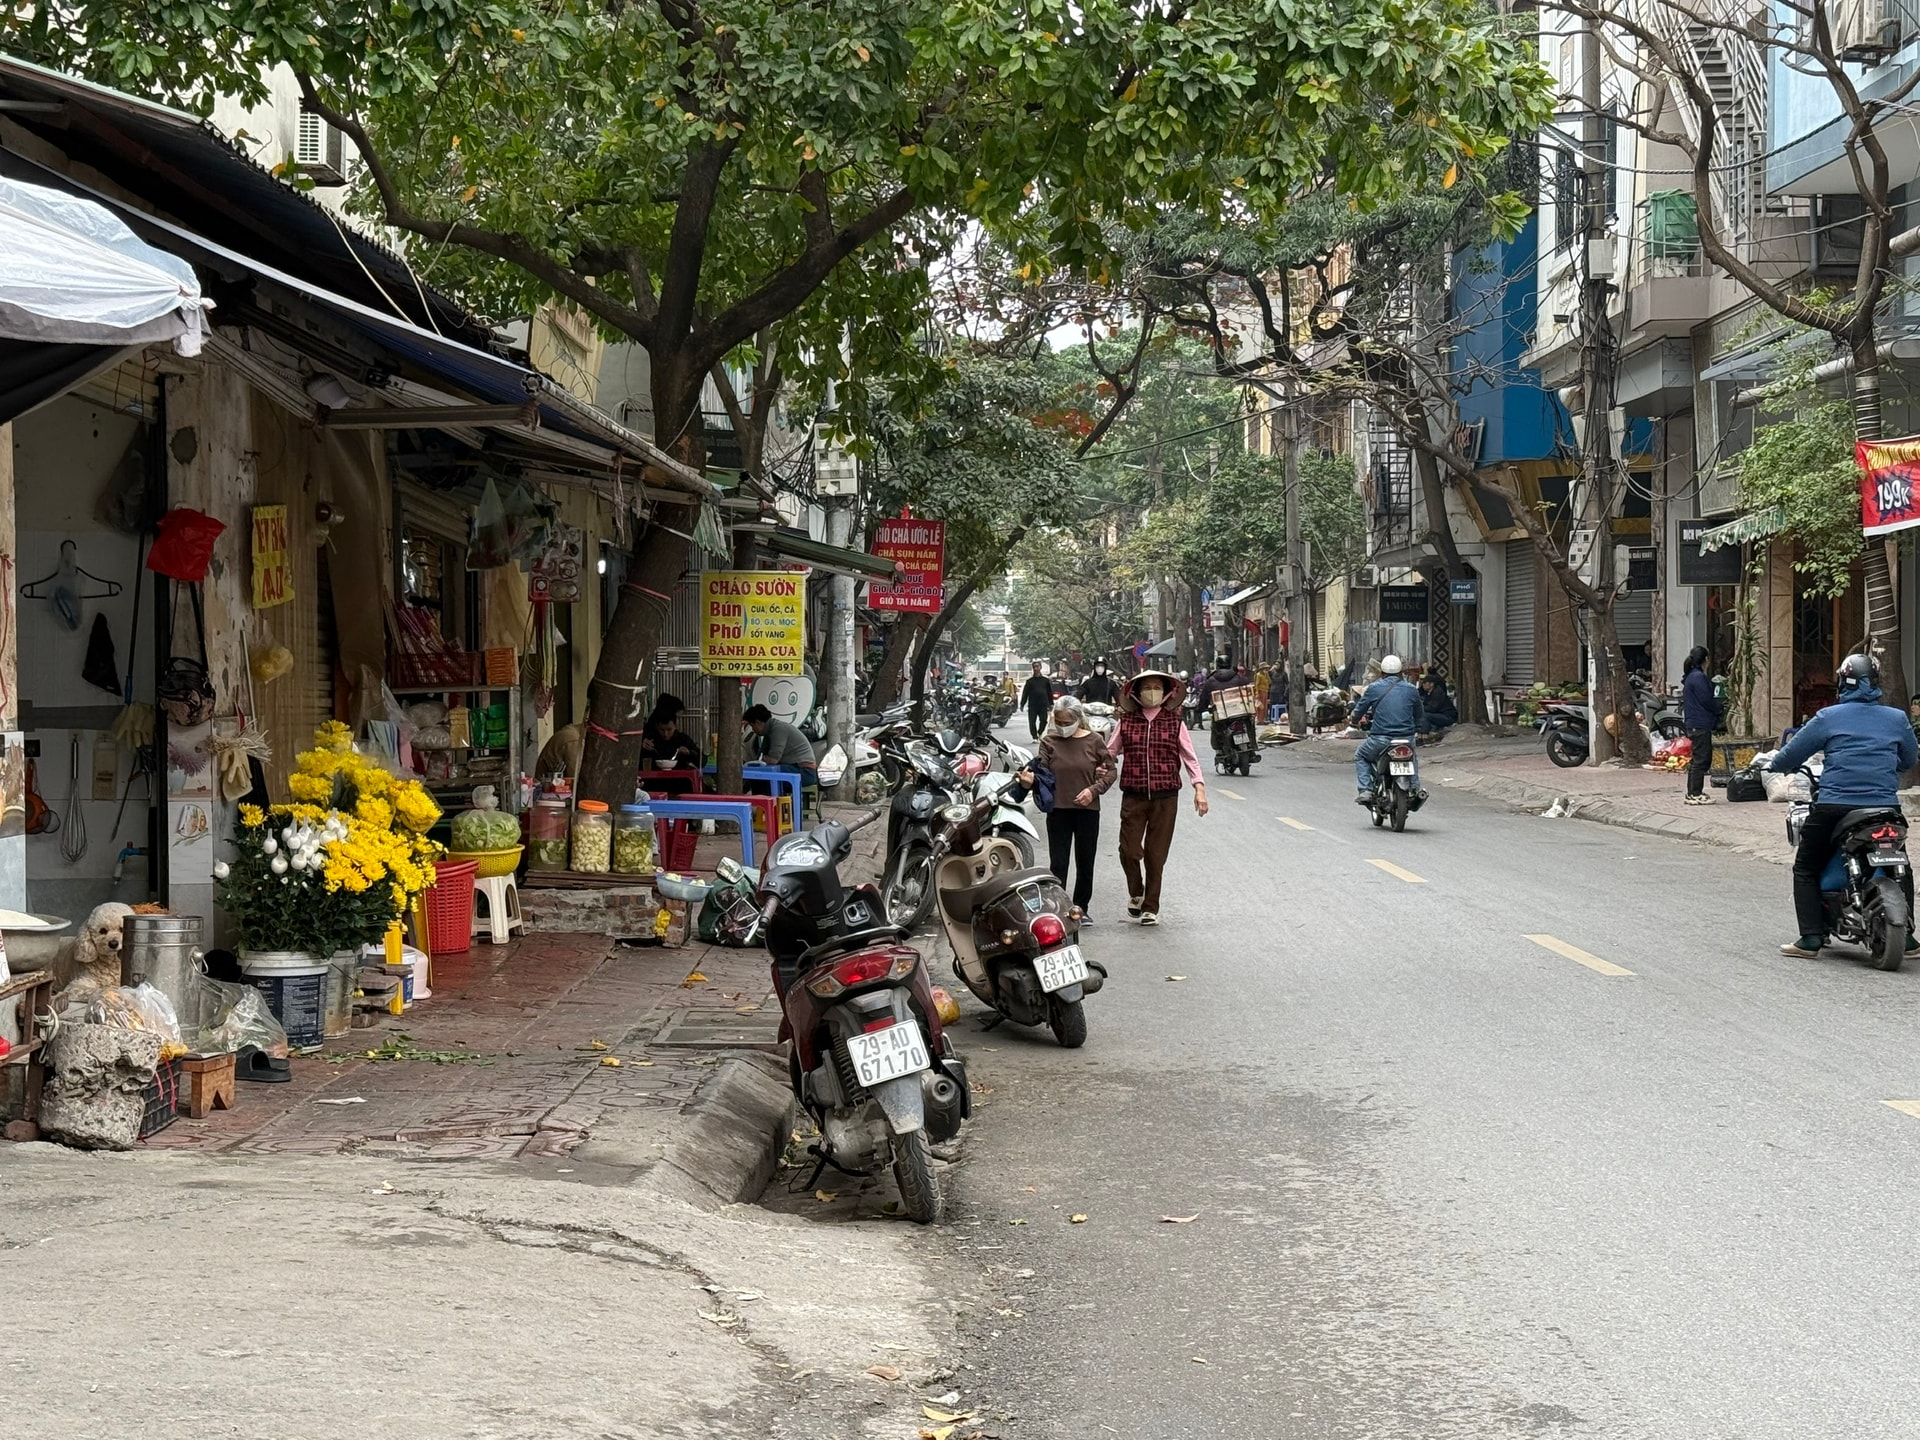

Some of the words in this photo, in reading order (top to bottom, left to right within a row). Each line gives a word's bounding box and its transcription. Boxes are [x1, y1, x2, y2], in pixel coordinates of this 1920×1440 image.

[892, 523, 909, 544] CHẢ
[911, 525, 929, 545] ƯỚC
[930, 524, 940, 546] LỄ
[878, 547, 894, 557] CHẢ
[897, 549, 915, 559] SỤN
[905, 560, 920, 570] CHẢ
[709, 577, 751, 595] CHÁO
[755, 578, 796, 596] SƯỜN
[710, 601, 742, 617] Bún
[751, 605, 767, 614] CUA,
[769, 603, 782, 614] ỐC,
[880, 596, 894, 605] GIÒ
[896, 597, 908, 606] TAI
[709, 621, 742, 639] Phở
[751, 629, 763, 638] SỐT
[708, 643, 744, 656] BÁNH
[748, 646, 766, 656] ĐA
[770, 646, 796, 656] CUA
[728, 663, 774, 671] 0973.545
[777, 663, 794, 671] 891
[1041, 950, 1077, 973] 29-AA
[1043, 964, 1083, 989] 687.17
[858, 1027, 910, 1059] 29-AD
[860, 1046, 923, 1082] 671.70
